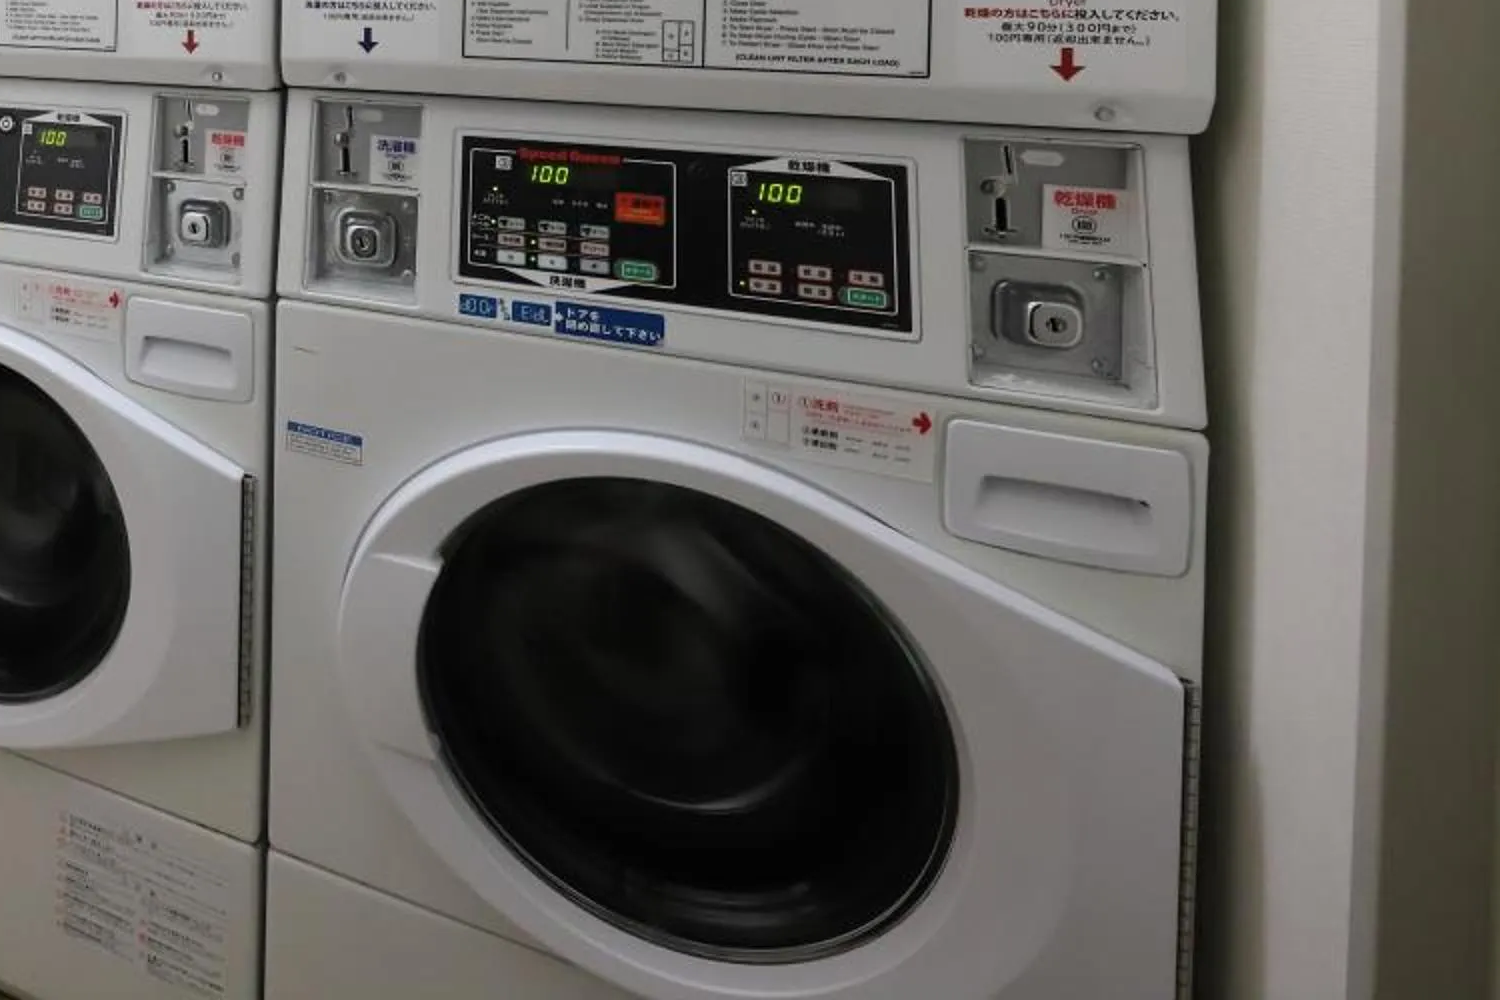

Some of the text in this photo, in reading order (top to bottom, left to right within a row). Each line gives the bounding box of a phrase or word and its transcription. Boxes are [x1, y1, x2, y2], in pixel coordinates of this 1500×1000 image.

[41, 129, 67, 147] 100
[531, 165, 569, 184] 100
[758, 182, 803, 204] 100
[1053, 190, 1116, 211] 乾燥機
[566, 307, 600, 320] ドアを
